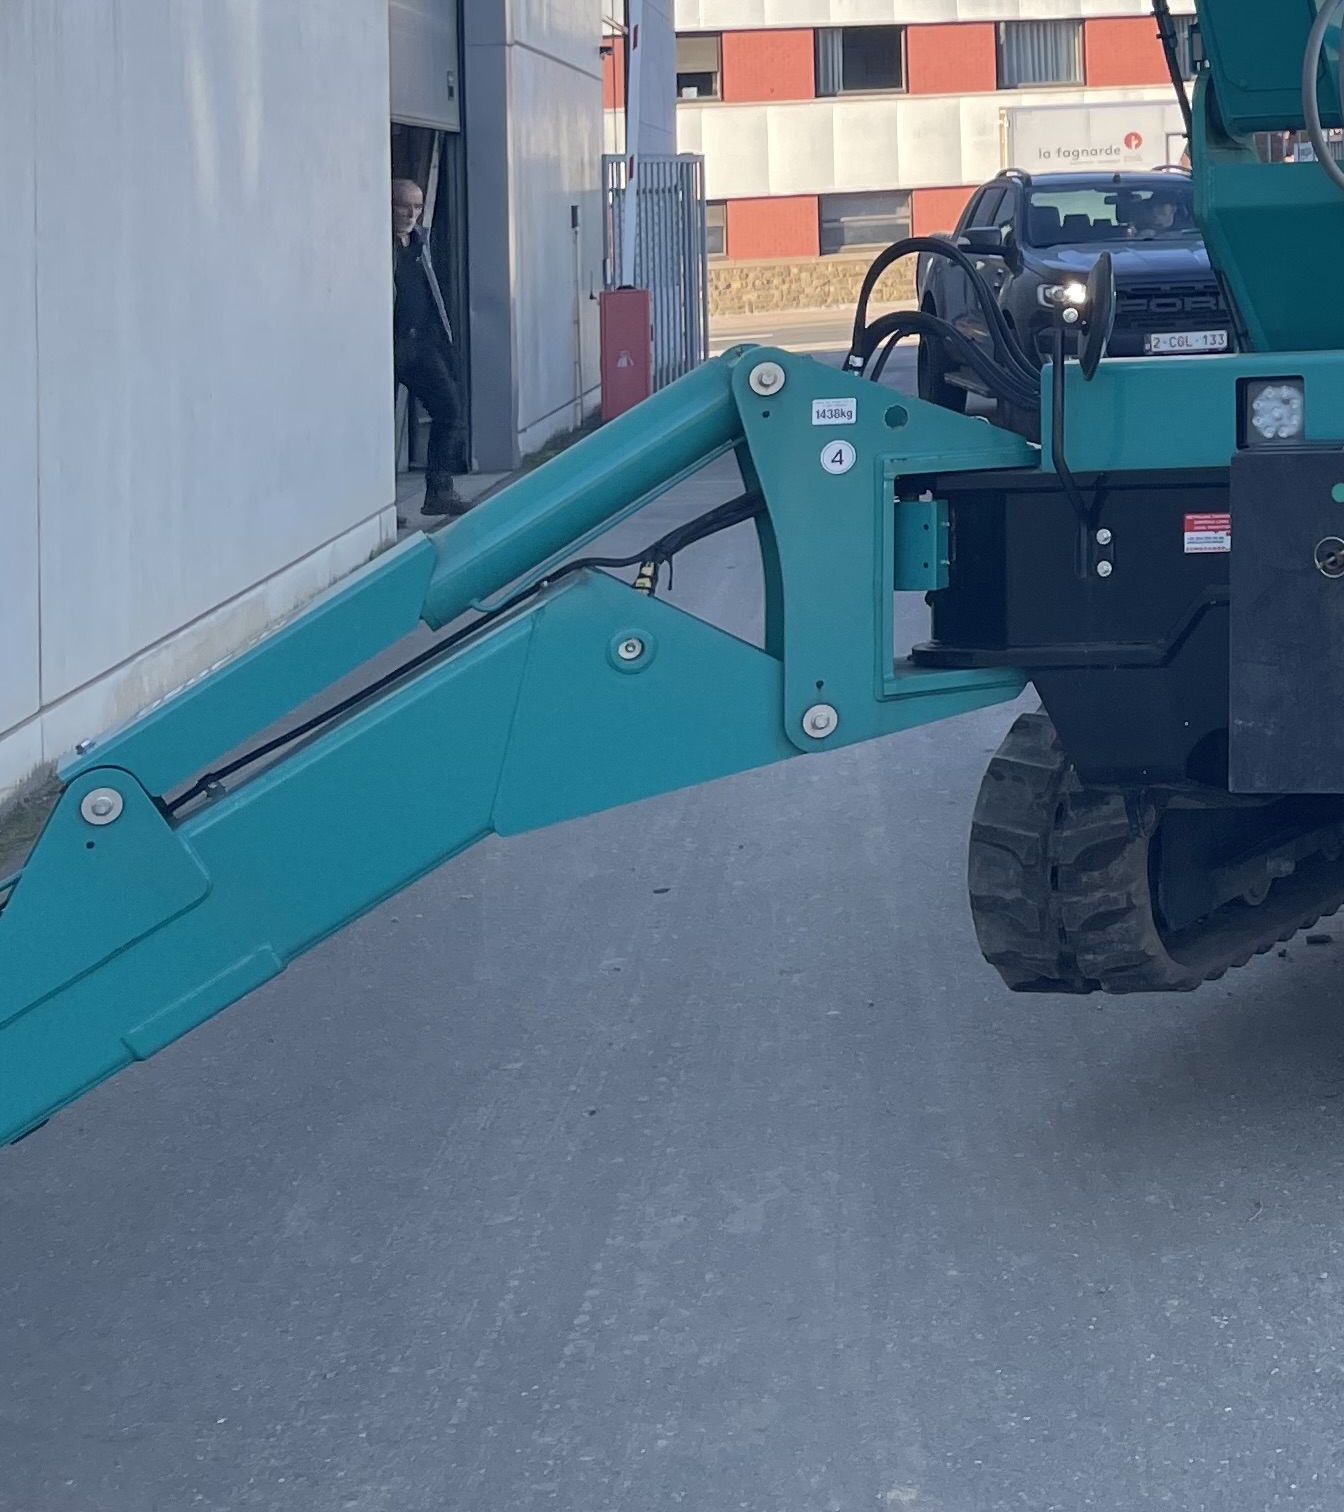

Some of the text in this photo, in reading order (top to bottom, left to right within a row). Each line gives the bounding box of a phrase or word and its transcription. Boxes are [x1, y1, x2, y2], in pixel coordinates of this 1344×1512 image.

[1038, 148, 1051, 159] la
[1056, 144, 1121, 161] fagnarde
[816, 408, 853, 420] 1438kg
[831, 449, 844, 465] 4
